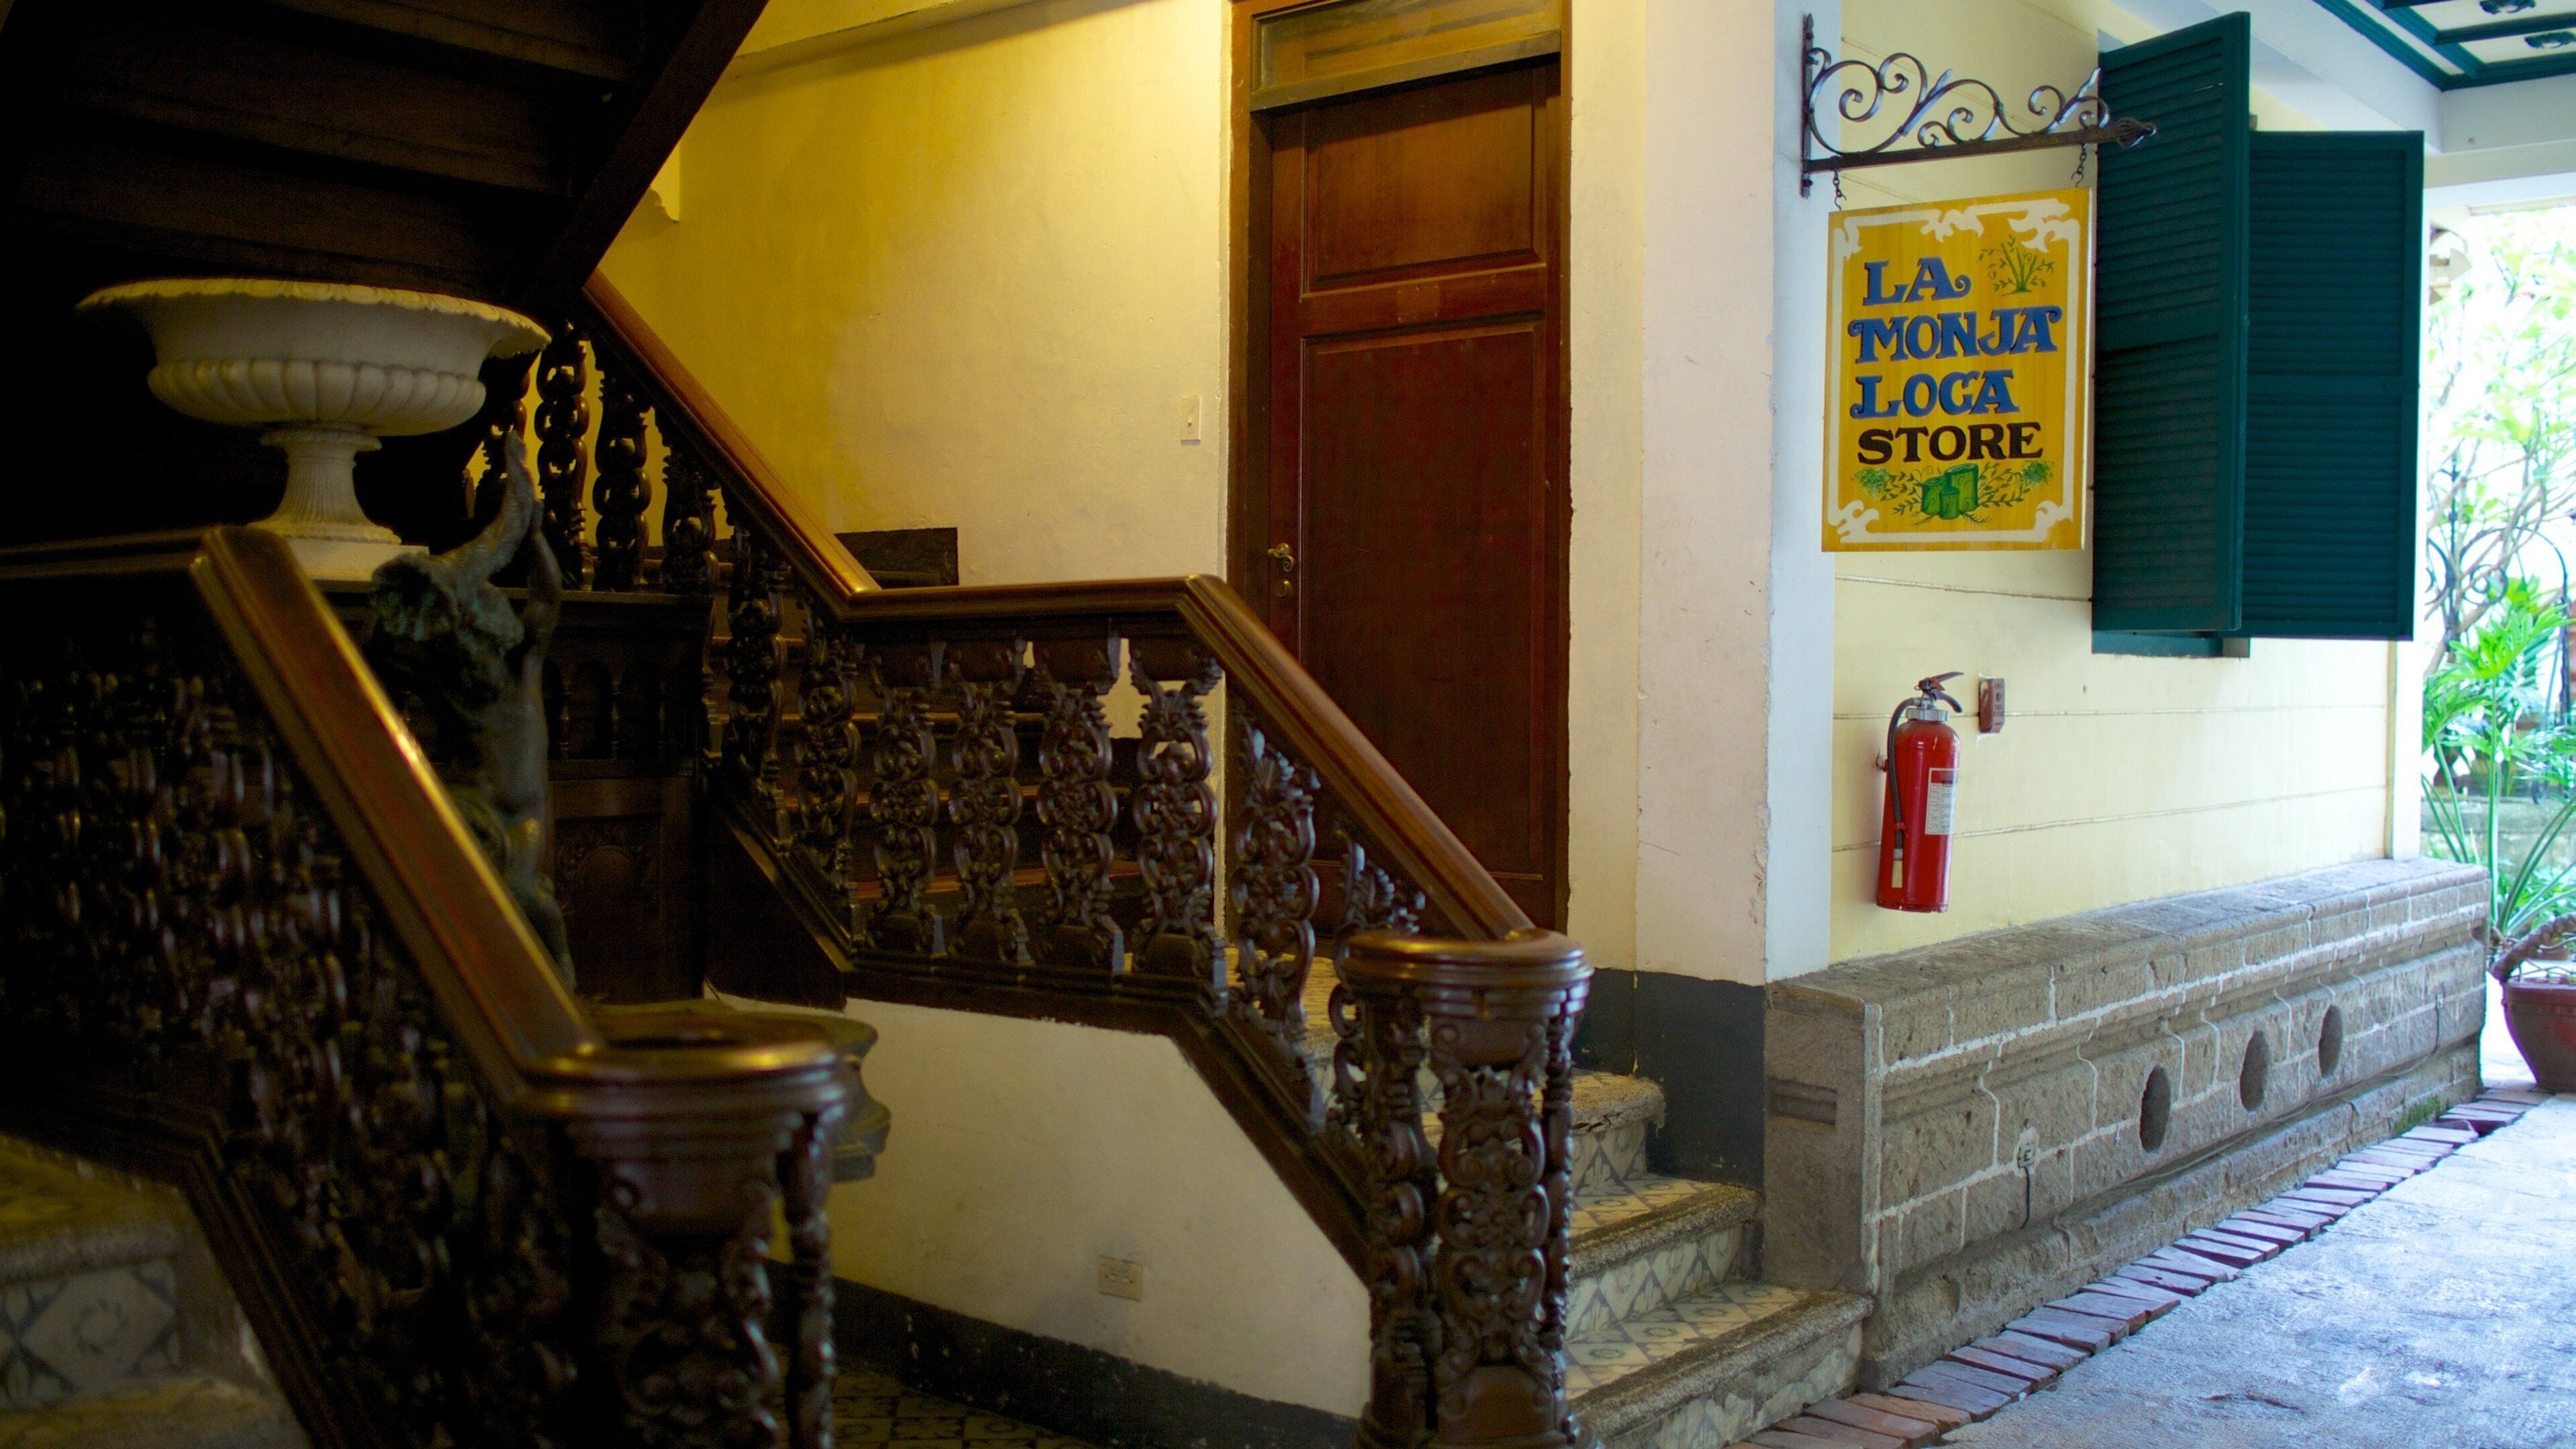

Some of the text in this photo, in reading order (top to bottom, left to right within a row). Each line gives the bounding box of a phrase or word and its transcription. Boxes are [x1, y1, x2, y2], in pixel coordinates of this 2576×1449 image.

[1864, 256, 1971, 305] LA
[1848, 305, 2062, 364] MONJA
[1858, 423, 2043, 465] STORE
